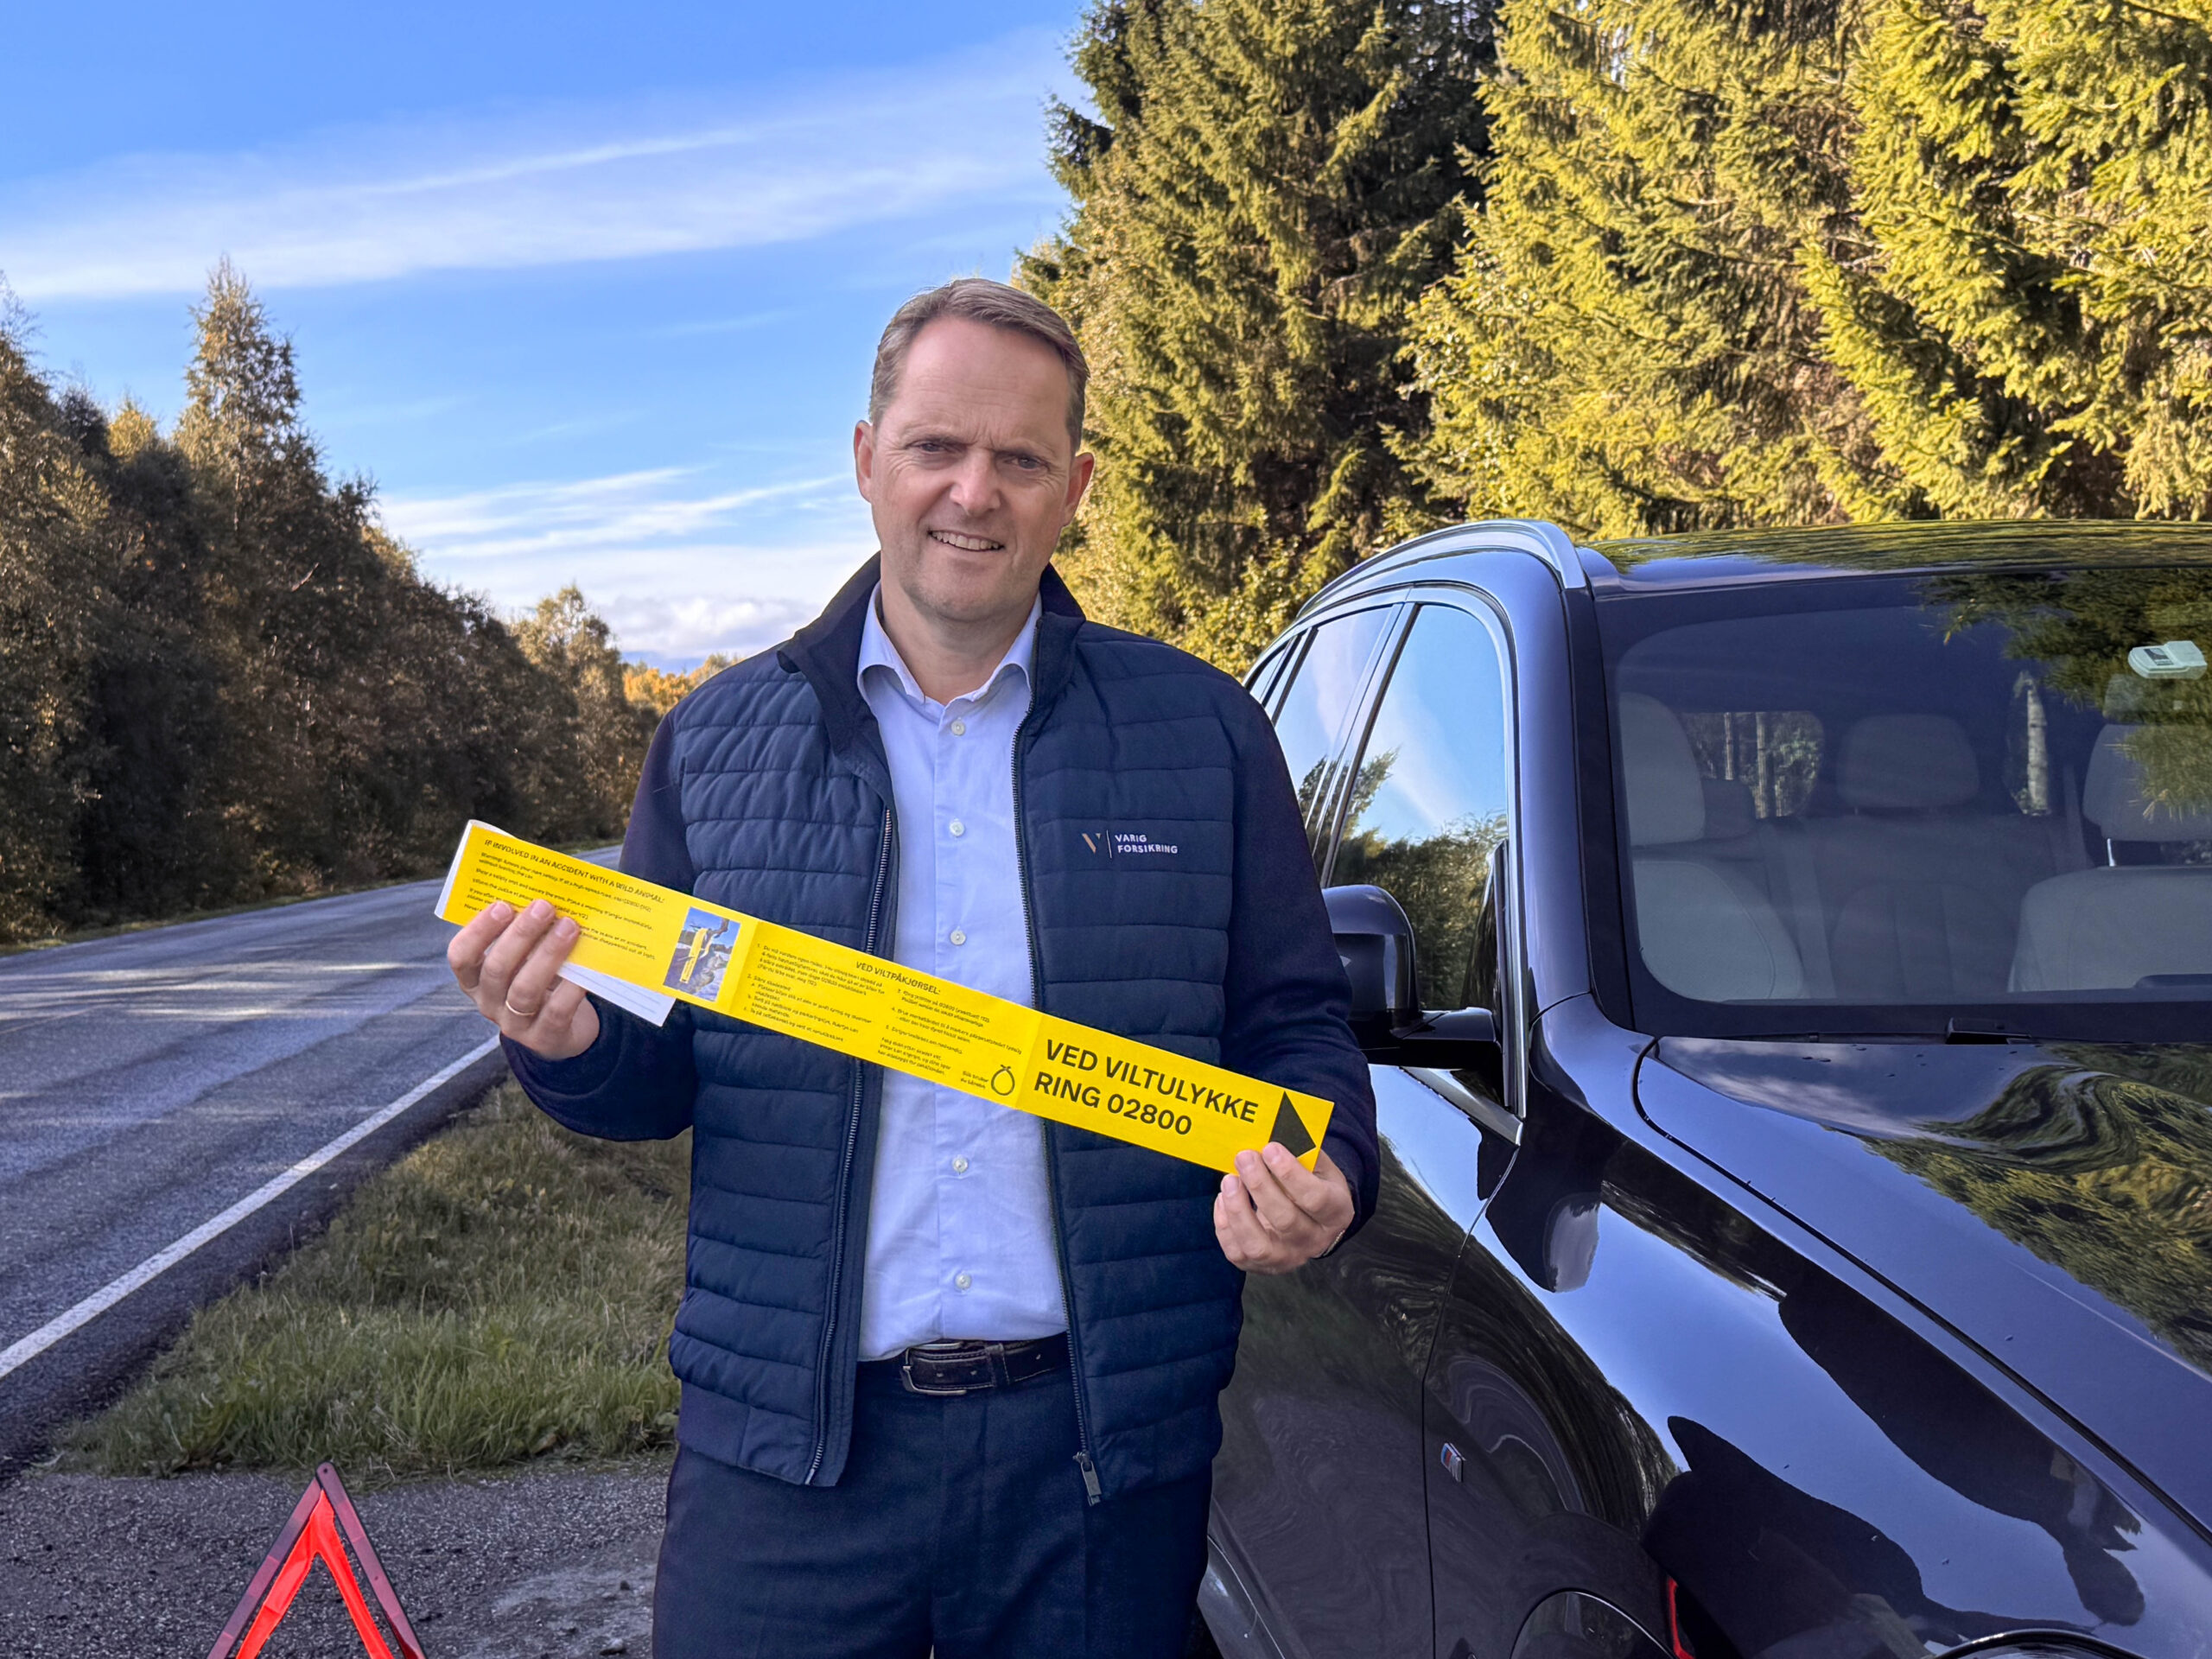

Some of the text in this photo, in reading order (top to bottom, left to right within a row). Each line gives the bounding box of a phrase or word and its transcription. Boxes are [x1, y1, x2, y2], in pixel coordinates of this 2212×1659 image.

[1115, 834, 1147, 843] VARIG
[1117, 843, 1179, 855] FORSIKRING
[493, 842, 530, 859] INVOLVED
[539, 857, 551, 866] AN
[551, 861, 589, 878] ACCIDENT
[589, 874, 609, 885] WITH
[615, 882, 634, 893] WILD
[856, 961, 874, 973] VED
[1047, 1039, 1259, 1123] VED VILTULYKKE
[1034, 1071, 1192, 1135] RING 02800
